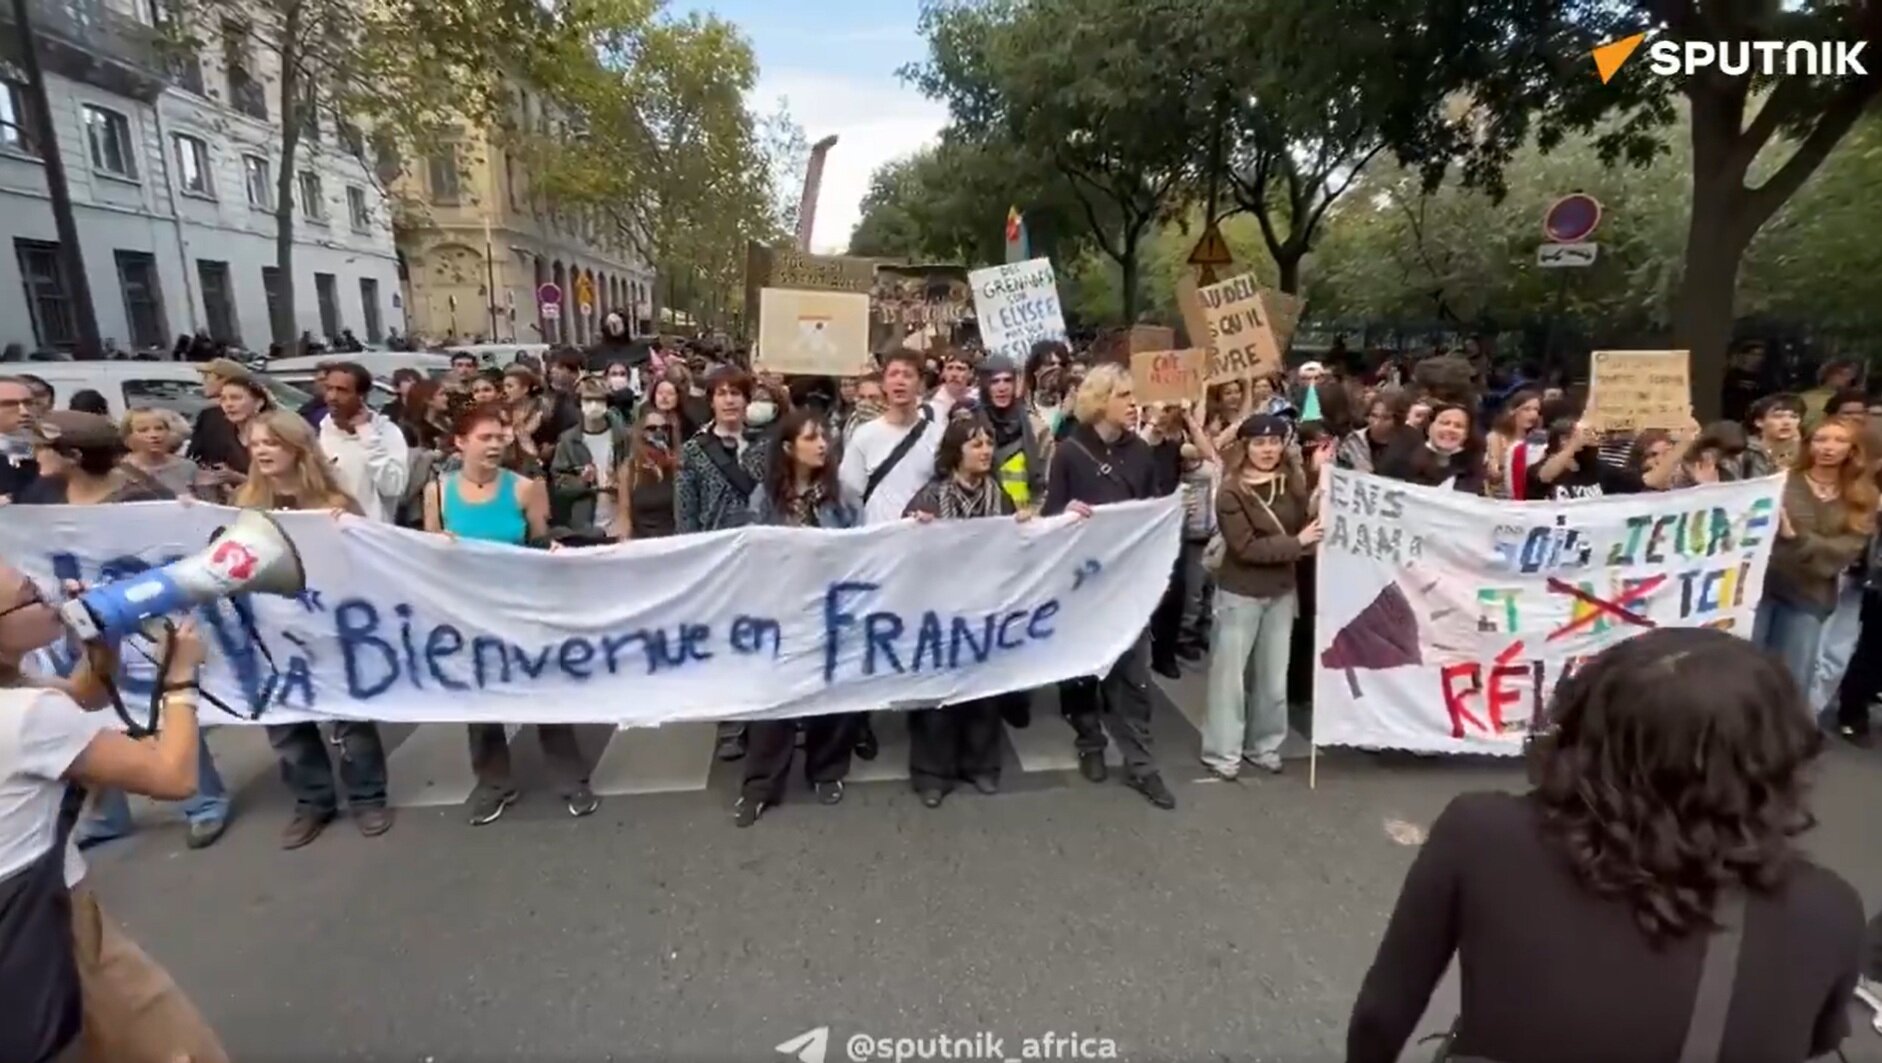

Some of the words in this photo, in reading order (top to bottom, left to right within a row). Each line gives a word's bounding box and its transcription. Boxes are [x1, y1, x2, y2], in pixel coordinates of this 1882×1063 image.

[1329, 474, 1405, 519] ENS
[1606, 498, 1774, 565] JEUNE
[729, 614, 781, 658] en
